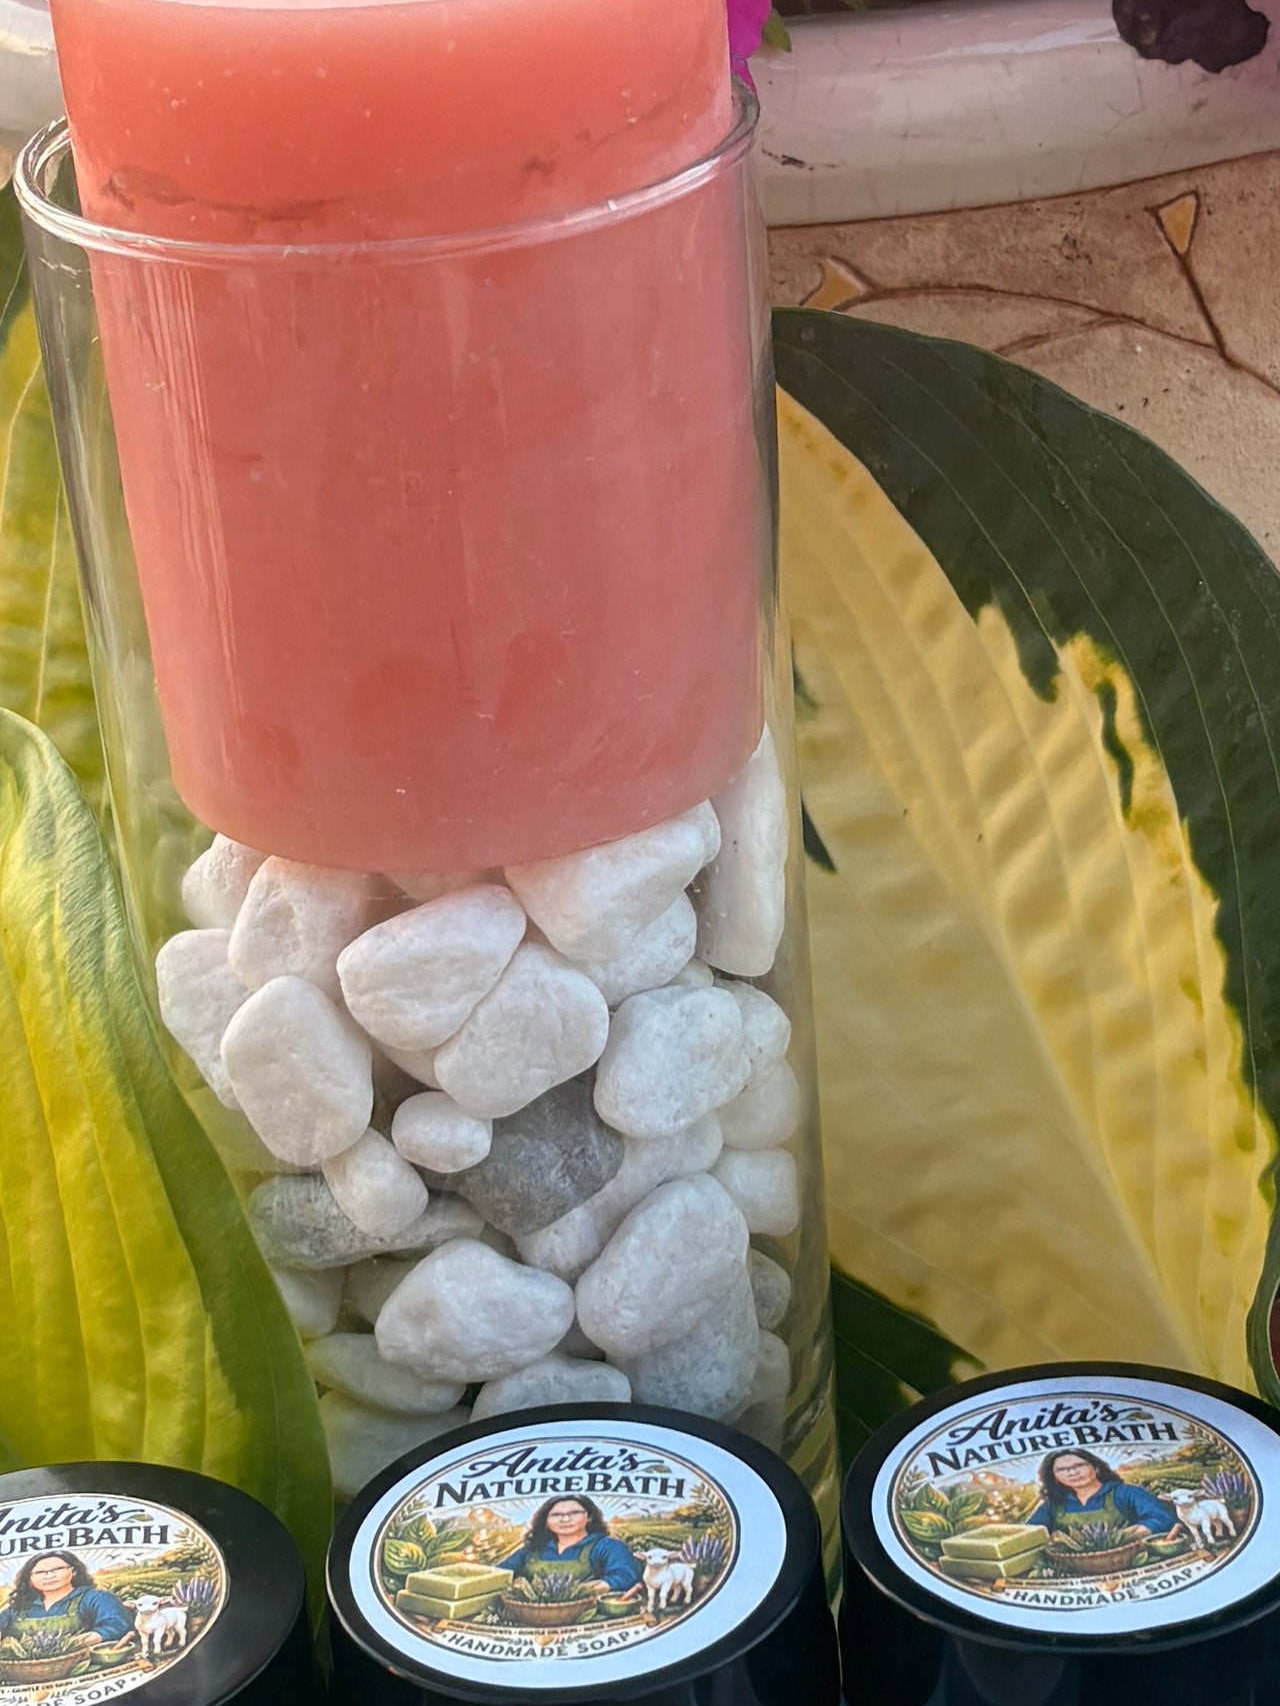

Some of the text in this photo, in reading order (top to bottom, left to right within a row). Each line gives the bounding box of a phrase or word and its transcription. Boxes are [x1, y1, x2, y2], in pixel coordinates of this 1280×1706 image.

[946, 1400, 1141, 1446] Anita's
[462, 1446, 664, 1479] Anita's
[1013, 1590, 1140, 1606] HANDMADE
[1145, 1567, 1194, 1594] SOAP
[448, 1631, 630, 1658] HANDMADE SOAP
[74, 1678, 126, 1705] SOAP
